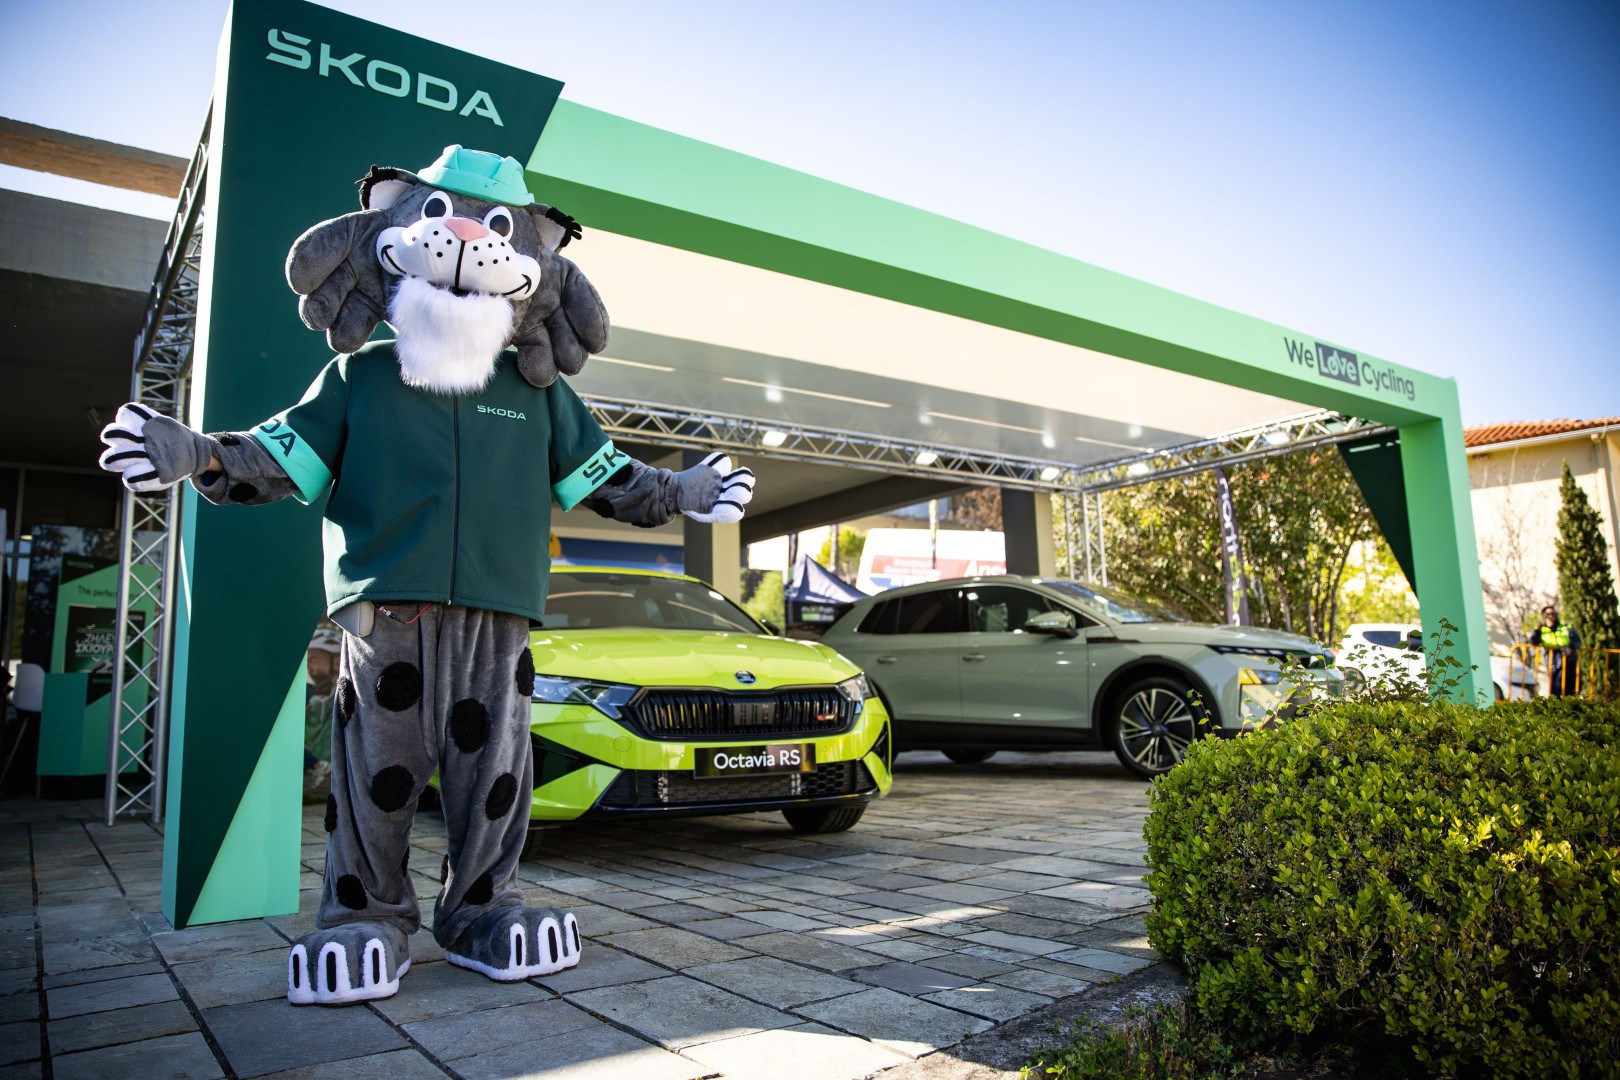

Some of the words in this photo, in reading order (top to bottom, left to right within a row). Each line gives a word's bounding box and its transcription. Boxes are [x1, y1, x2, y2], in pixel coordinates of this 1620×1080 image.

[1283, 336, 1315, 369] We
[1317, 346, 1358, 381] Love
[1361, 361, 1416, 402] Cycling
[713, 751, 776, 770] Octavia
[779, 749, 801, 766] RS
